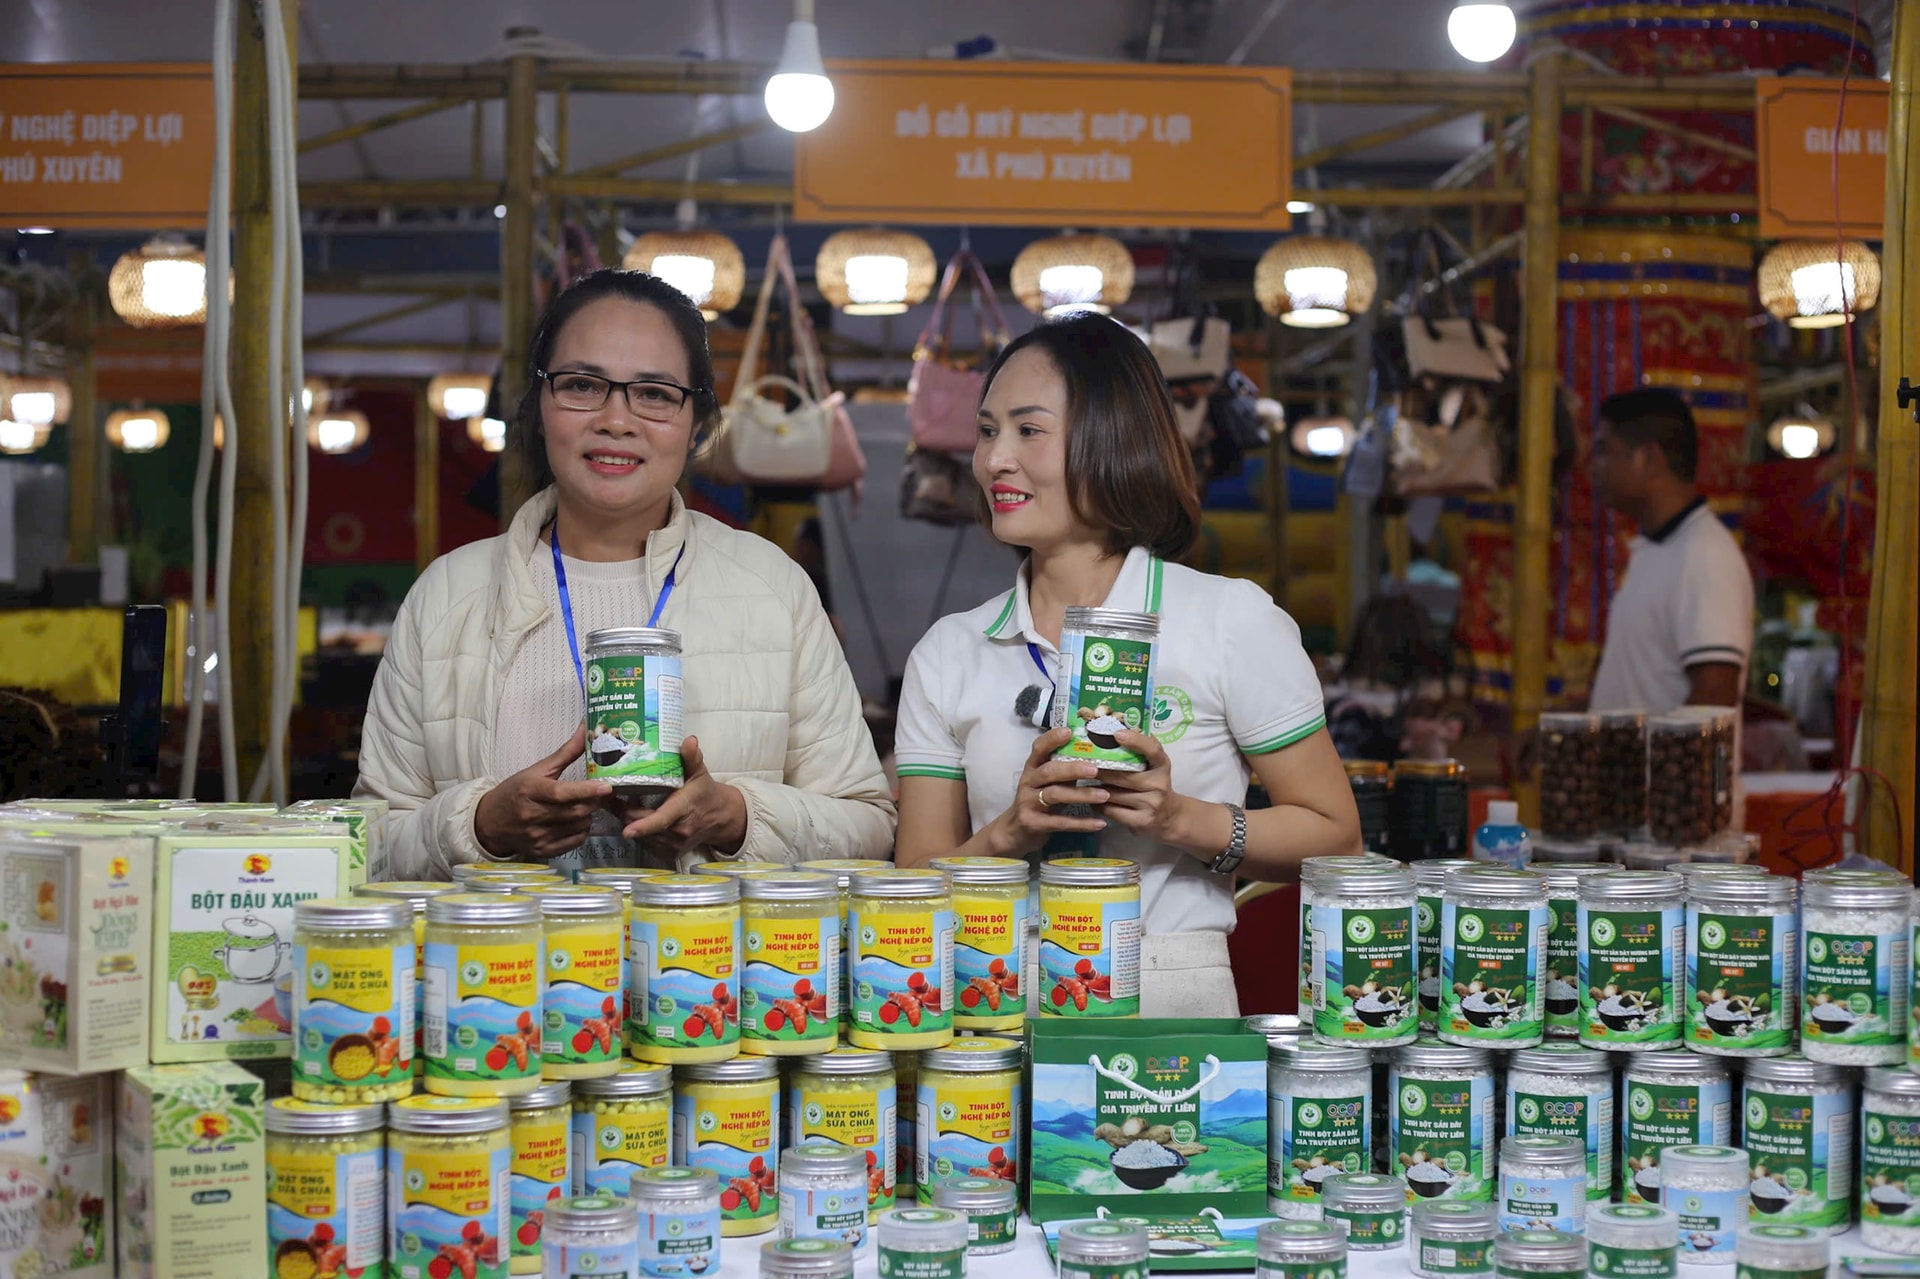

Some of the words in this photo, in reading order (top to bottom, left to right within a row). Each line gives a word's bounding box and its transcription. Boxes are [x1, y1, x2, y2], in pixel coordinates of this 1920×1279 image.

[11, 108, 76, 147] NGHỆ
[82, 108, 138, 147] DIỆP
[144, 112, 183, 148] LỢI
[42, 150, 123, 183] XUYÊN
[191, 890, 225, 913] BỘT
[230, 890, 266, 912] ĐẬU
[964, 914, 988, 923] TINH
[990, 913, 1008, 924] BỘT
[1058, 914, 1076, 923] TINH
[1077, 915, 1094, 923] BỘT
[910, 927, 926, 935] BỘT
[964, 925, 991, 936] NGHỆ
[992, 924, 1006, 935] ĐỎ
[1052, 923, 1071, 932] NGHỆ
[1072, 924, 1088, 932] NẾP
[1089, 924, 1101, 932] ĐỎ
[692, 937, 713, 946] TINH
[714, 936, 728, 944] BỘT
[797, 932, 813, 941] BỘT
[879, 937, 902, 945] NGHỆ
[904, 936, 920, 944] NẾP
[922, 935, 933, 944] ĐỎ
[684, 948, 707, 956] NGHỆ
[709, 946, 723, 955] NẾP
[766, 943, 788, 952] NGHỆ
[808, 942, 819, 950] ĐỎ
[1831, 940, 1873, 953] OCOP
[583, 949, 603, 958] TINH
[489, 961, 515, 971] TINH
[488, 974, 518, 985] NGHỆ
[1146, 1056, 1189, 1069] OCOP
[1104, 1090, 1128, 1099] TINH
[990, 1102, 1005, 1110] BỘT
[1100, 1104, 1117, 1114] GIA
[1120, 1102, 1158, 1114] TRUYỀN
[1160, 1102, 1172, 1113] ÚT
[1175, 1102, 1196, 1113] LIÊN
[1327, 1102, 1361, 1117] OCOP
[1543, 1101, 1584, 1114] OCOP
[729, 1112, 750, 1120] TINH
[752, 1110, 765, 1119] BỘT
[849, 1110, 870, 1118] ONG
[961, 1113, 983, 1121] NGHỆ
[985, 1112, 1000, 1120] NẾP
[721, 1121, 744, 1130] NGHỆ
[746, 1120, 760, 1129] NẾP
[648, 1128, 664, 1138] ONG
[1317, 1130, 1331, 1138] BỘT
[1309, 1137, 1337, 1146] TRUYỀN
[1338, 1137, 1347, 1146] ÚT
[438, 1170, 462, 1179] TINH
